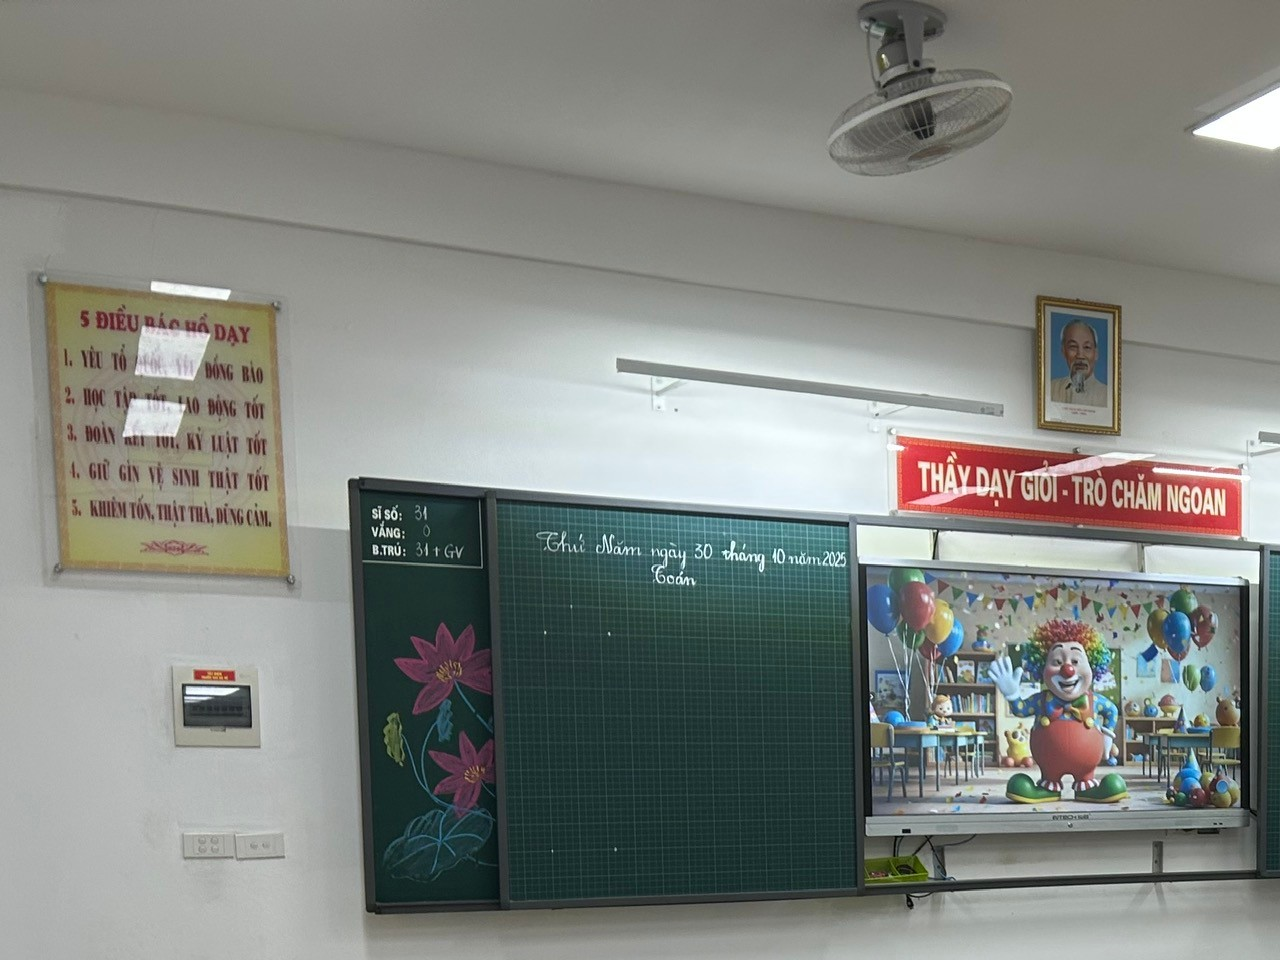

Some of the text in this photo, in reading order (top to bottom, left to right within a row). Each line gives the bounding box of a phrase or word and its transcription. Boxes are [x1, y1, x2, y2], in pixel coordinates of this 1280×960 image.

[80, 310, 90, 328] 5
[96, 305, 139, 332] ĐIỀU
[214, 324, 251, 347] DẠY
[64, 349, 73, 367] 1.
[81, 345, 103, 370] YÊU
[111, 344, 127, 372] TỔ
[242, 361, 264, 385] BÀO
[65, 388, 75, 405] 2.
[83, 388, 106, 413] HỌC
[208, 394, 237, 422] ĐỘNG
[244, 394, 265, 420] TỐT
[67, 423, 77, 442] 3.
[85, 421, 116, 446] ĐOÀN
[187, 427, 202, 451] KỶ
[211, 431, 240, 459] LUẬT
[246, 431, 268, 456] TỐT
[69, 458, 270, 495] 4. GIỮ GÌN VỆ SINH THẬT TỐT
[917, 451, 970, 495] THẦY
[976, 466, 1016, 507] DẠY
[1021, 461, 1058, 503] GIỎI
[1072, 470, 1106, 507] TRÒ
[1111, 474, 1162, 511] CHĂM
[1167, 487, 1226, 517] NGOAN
[71, 494, 272, 528] 5. KHIÊM TỐN, THẬT THÀ, DŨNG CẢM.
[371, 504, 428, 521] SĨ SỐ: 31
[371, 521, 431, 539] VẮNG: 0
[371, 542, 406, 557] B.TRÚ:
[415, 542, 429, 557] 31
[444, 543, 464, 559] GV
[536, 530, 847, 573] Thứ Năm ngày 30 tháng 10 năm 2025
[651, 563, 697, 586] Toán
